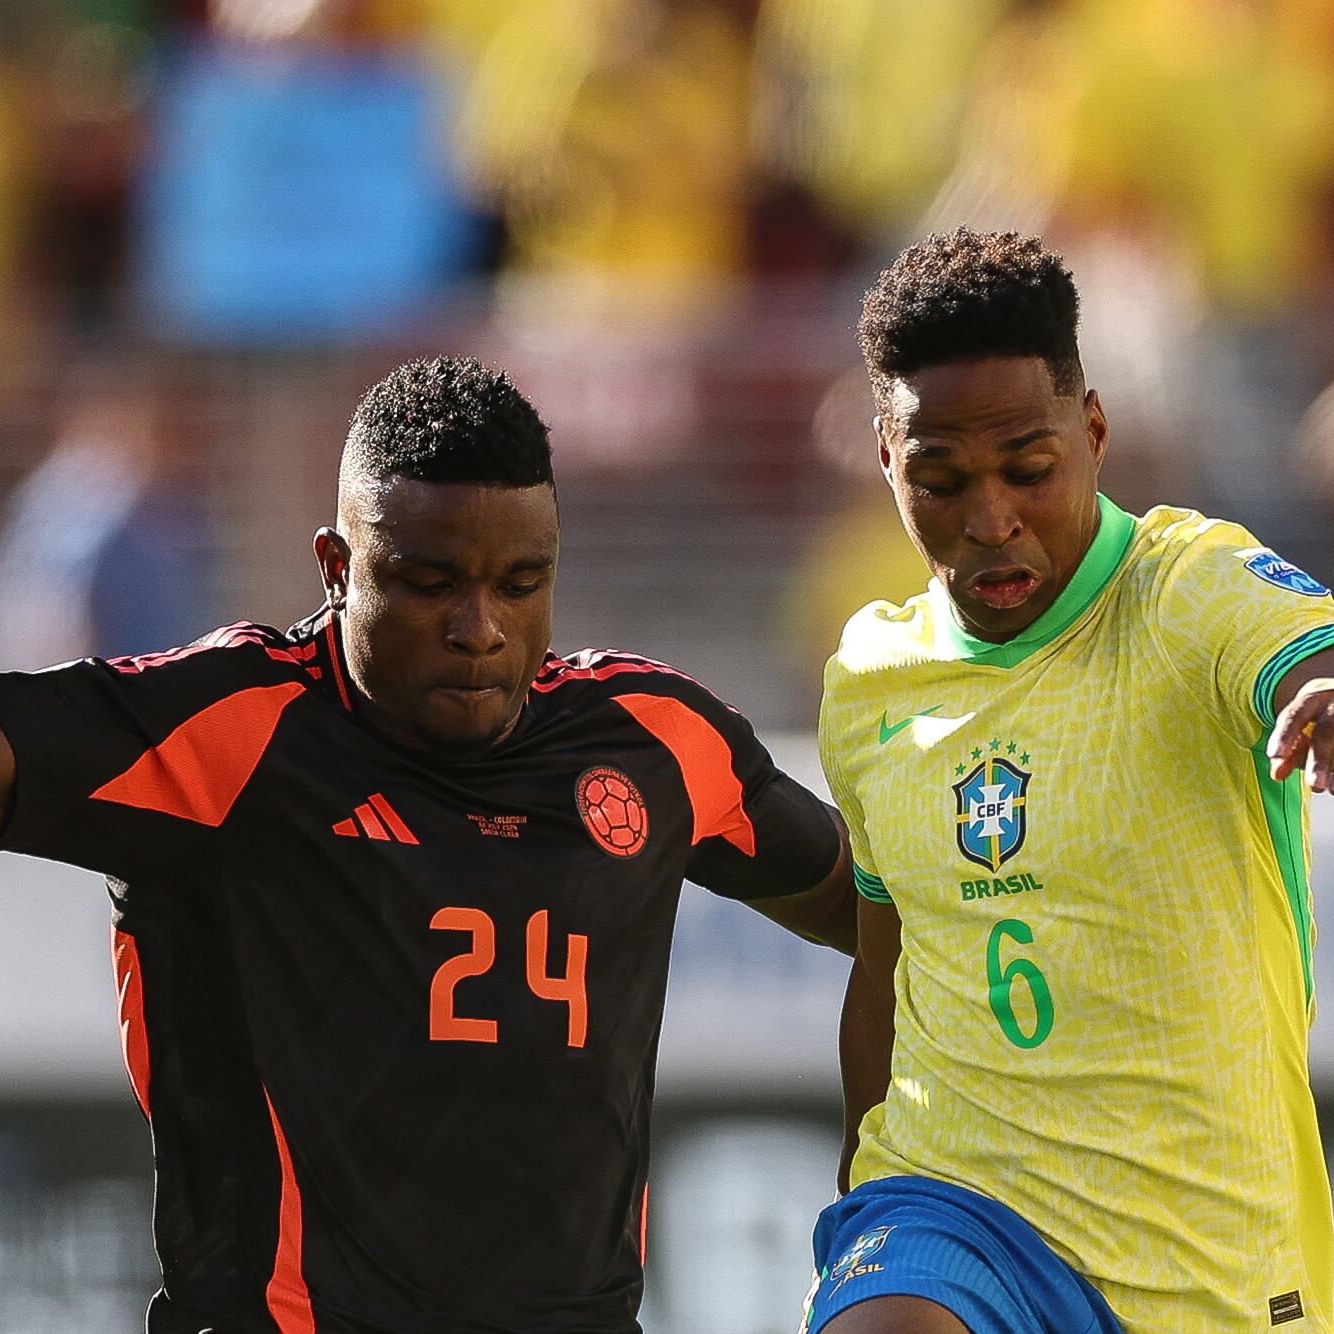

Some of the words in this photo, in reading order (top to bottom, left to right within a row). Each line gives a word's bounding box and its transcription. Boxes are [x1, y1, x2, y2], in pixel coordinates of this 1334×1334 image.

[977, 802, 1006, 818] CBF
[961, 872, 1043, 900] BRASIL
[429, 906, 588, 1048] 24
[986, 918, 1055, 1050] 6
